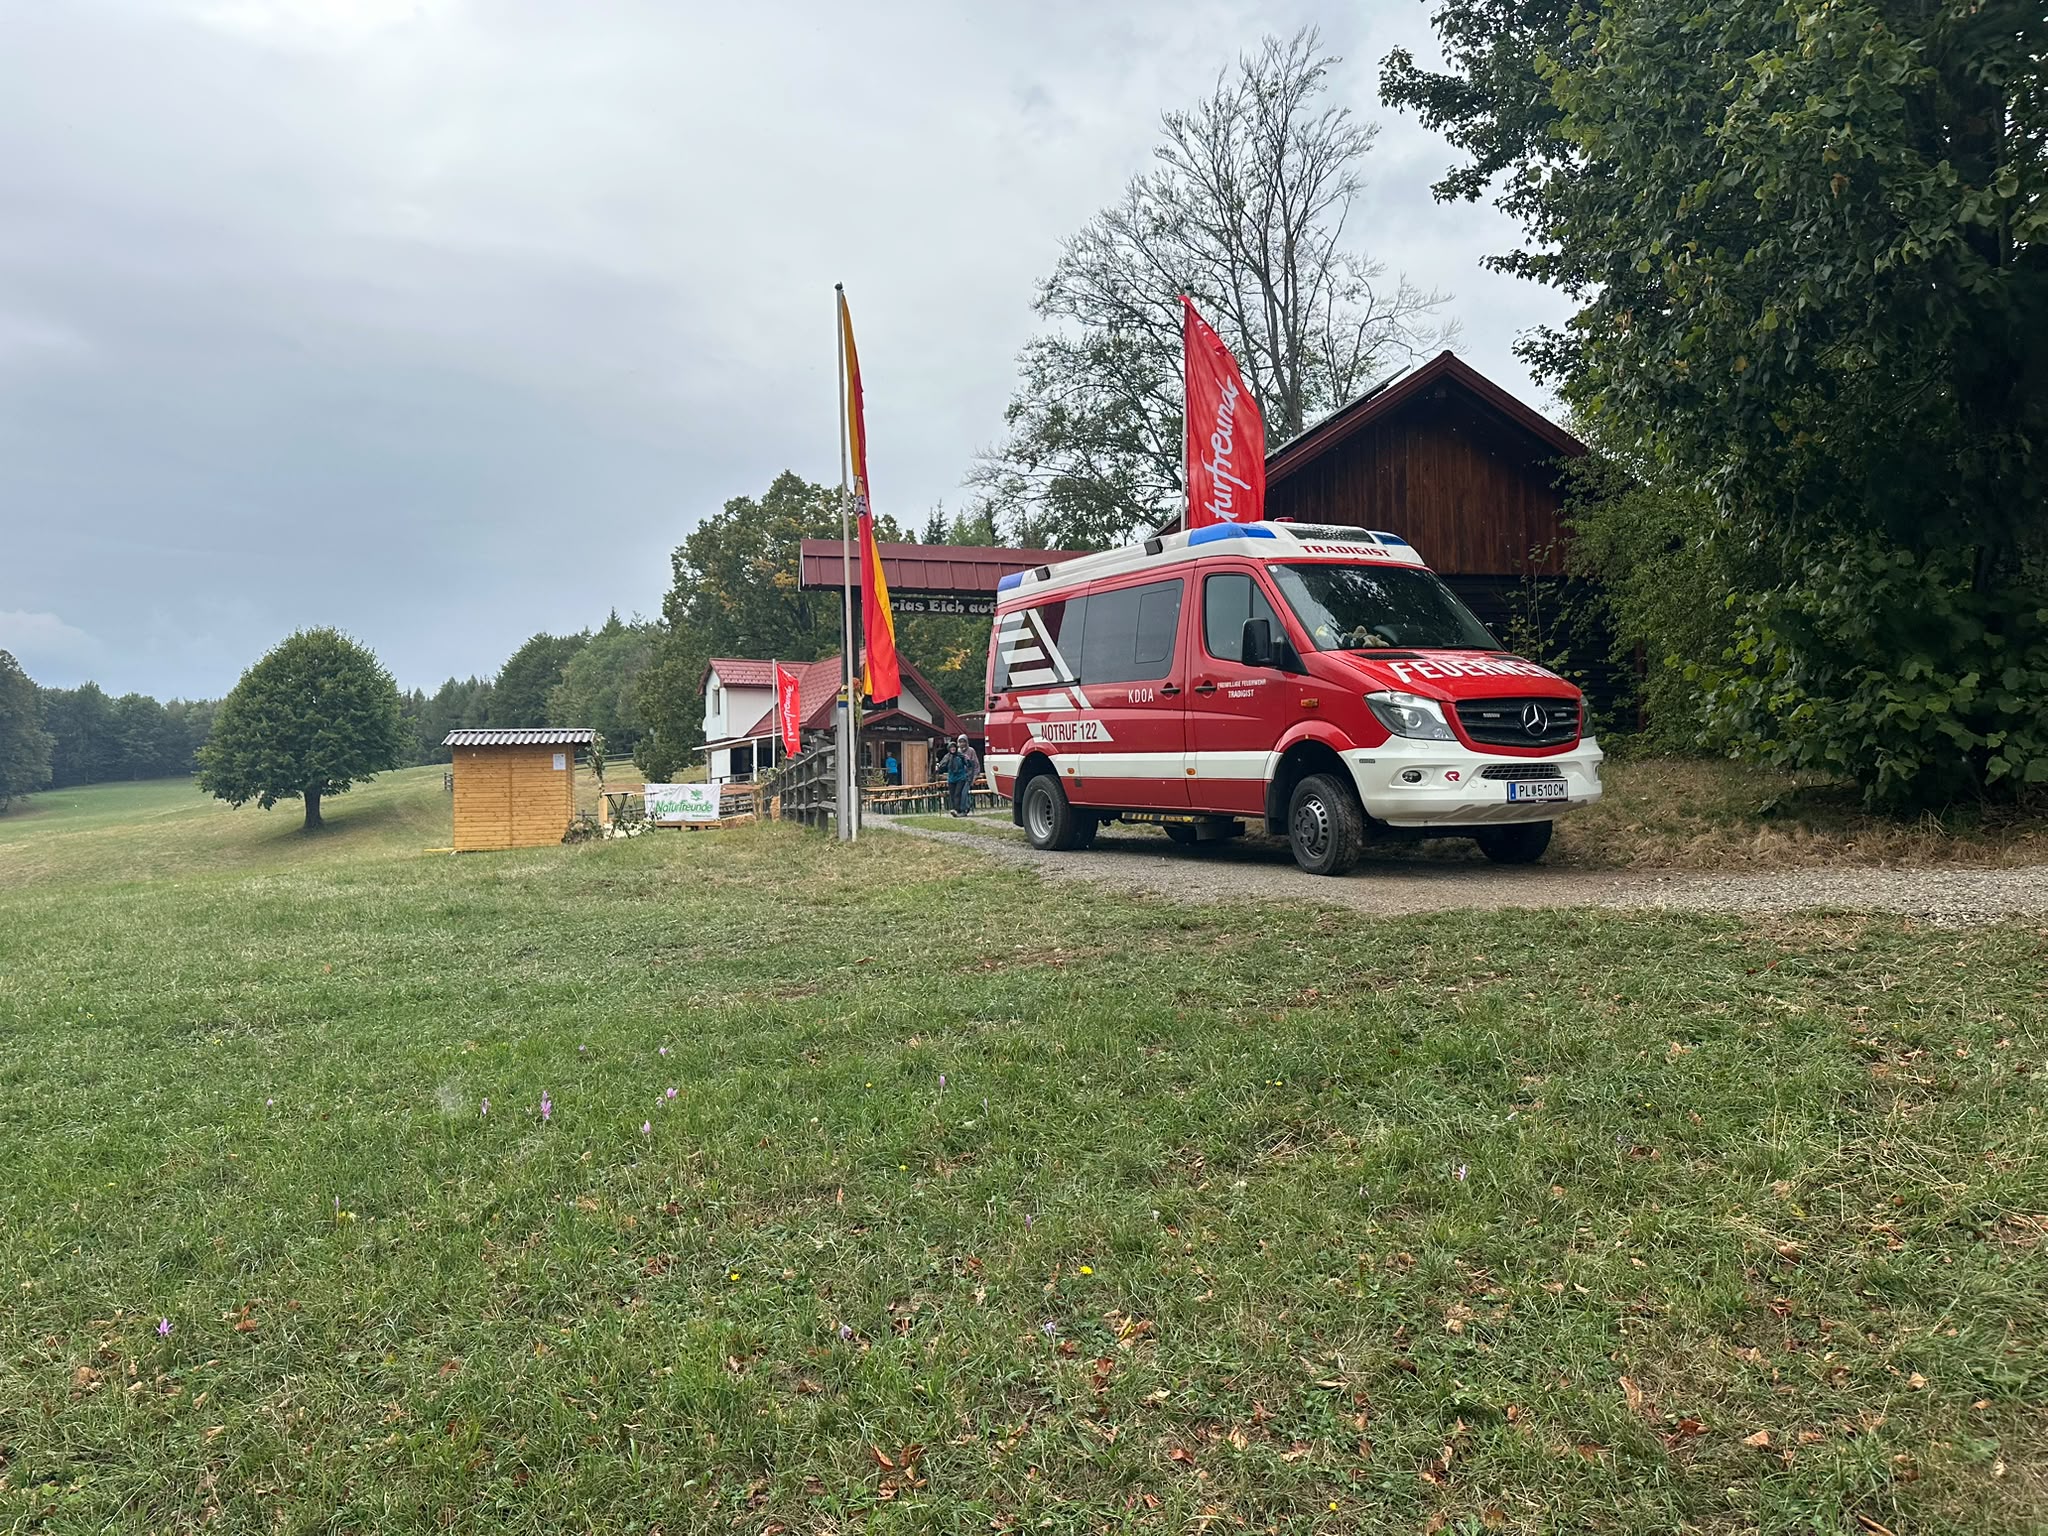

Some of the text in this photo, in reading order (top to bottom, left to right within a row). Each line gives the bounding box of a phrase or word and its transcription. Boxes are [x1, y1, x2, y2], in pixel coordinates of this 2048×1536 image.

[1300, 545, 1391, 557] TRADIGIST
[928, 600, 964, 614] Eich
[1128, 688, 1154, 703] KDOA
[1228, 689, 1254, 698] TRADIGIST
[1041, 722, 1098, 741] NOTRUF 122
[1519, 785, 1530, 797] PL
[656, 800, 713, 813] Naturfreunde
